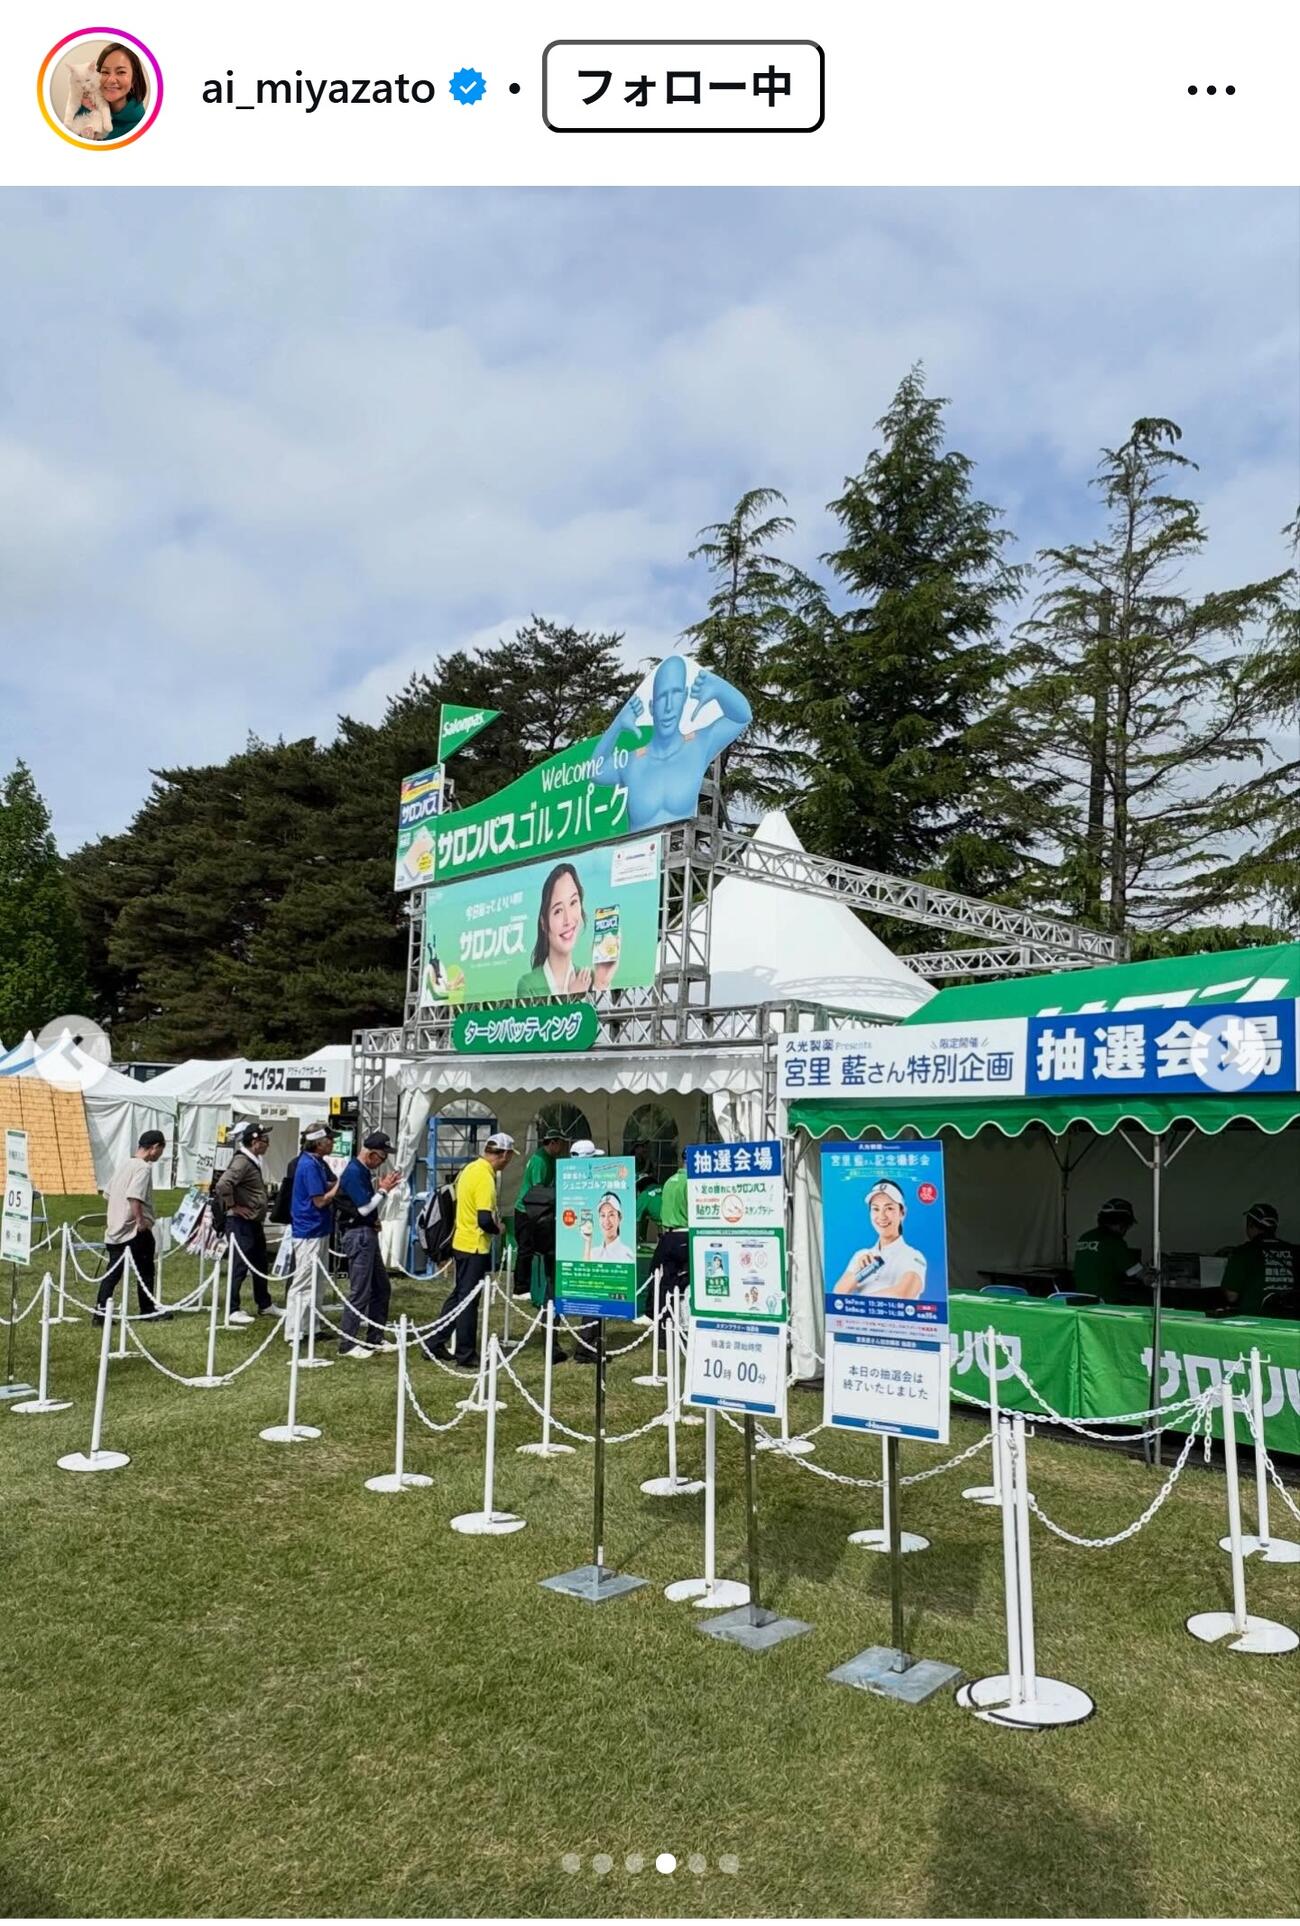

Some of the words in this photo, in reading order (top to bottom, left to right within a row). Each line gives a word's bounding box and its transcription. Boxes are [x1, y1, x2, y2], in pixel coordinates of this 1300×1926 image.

[442, 712, 485, 738] Salonpas
[541, 754, 604, 793] Welcome
[613, 746, 629, 770] to
[402, 795, 437, 824] サロンパス
[460, 923, 525, 962] サロンパス
[786, 1040, 834, 1052] 久光製薬
[939, 1038, 979, 1049] 限定開催
[1037, 1015, 1283, 1081] 抽選会場
[244, 1068, 284, 1090] フェイタス
[785, 1057, 832, 1087] 宮里
[840, 1052, 1014, 1085] 藍さん特別企画
[694, 1146, 773, 1174] 抽選会場
[703, 1358, 732, 1381] 10時
[737, 1361, 767, 1385] 00分
[849, 1365, 924, 1384] 本日の抽選会は
[843, 1379, 929, 1400] 終了いたしました
